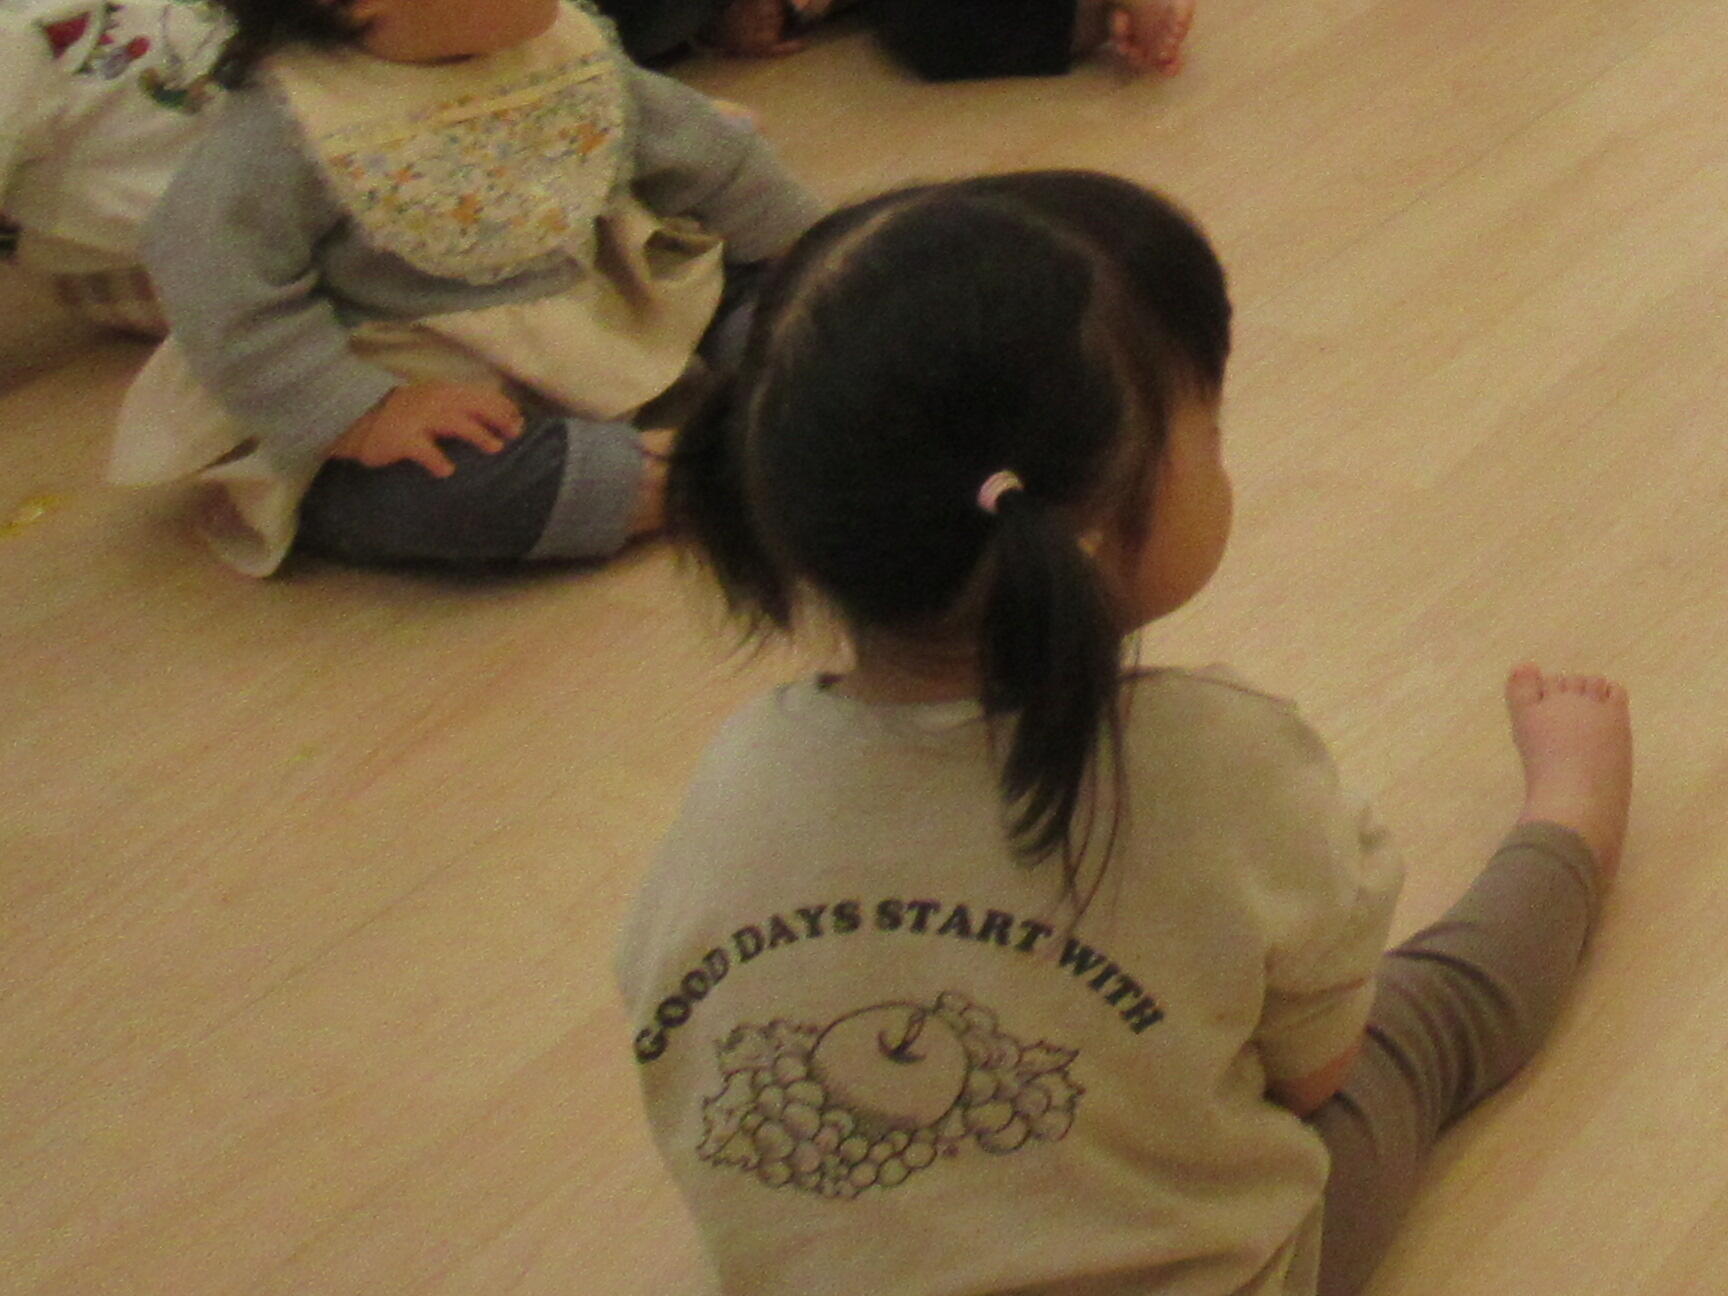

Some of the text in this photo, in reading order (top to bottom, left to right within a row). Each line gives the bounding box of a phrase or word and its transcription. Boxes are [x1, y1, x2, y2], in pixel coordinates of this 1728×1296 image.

[633, 897, 1166, 1065] GOOD DAYS START WITH
